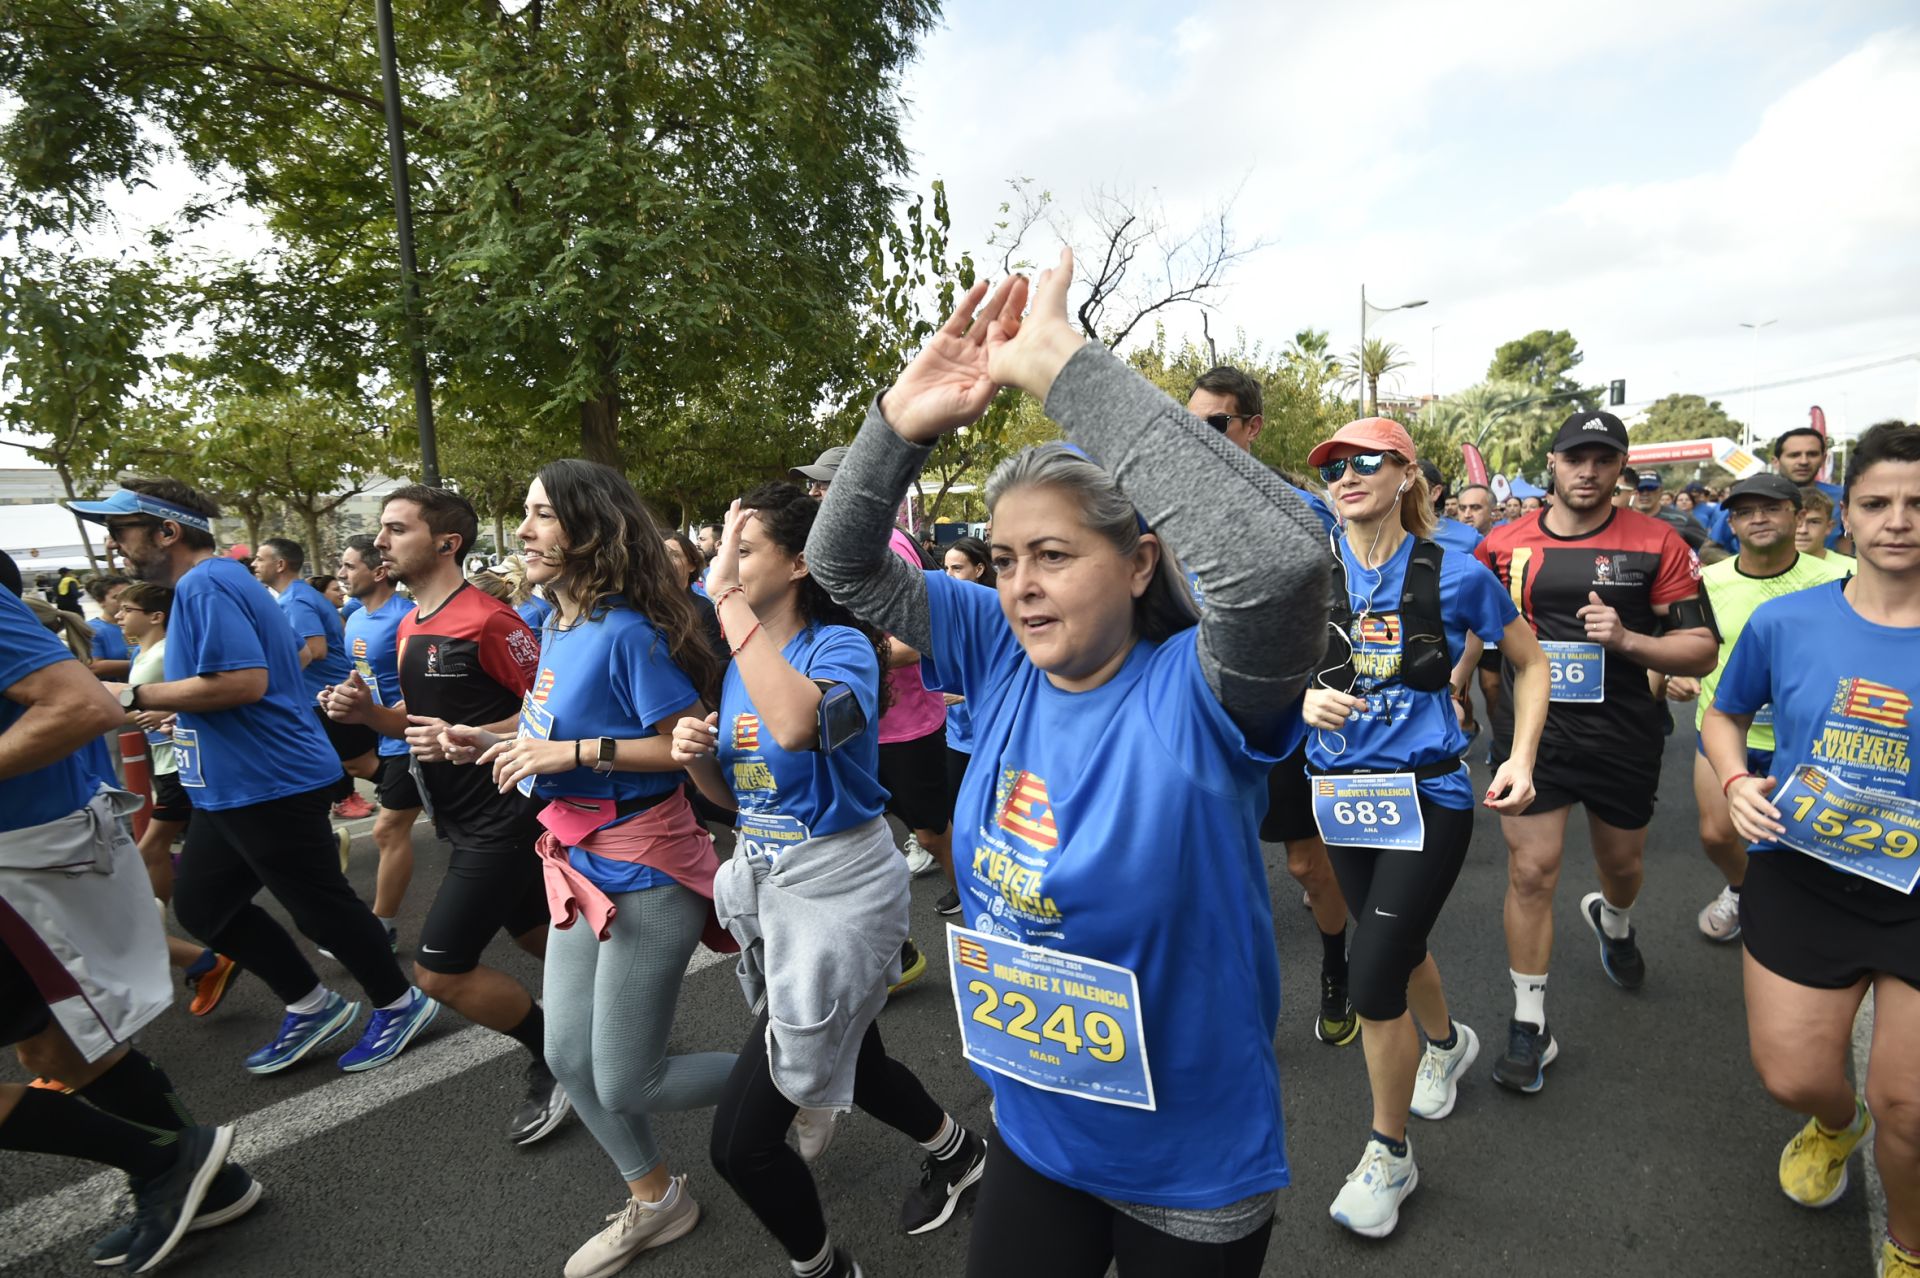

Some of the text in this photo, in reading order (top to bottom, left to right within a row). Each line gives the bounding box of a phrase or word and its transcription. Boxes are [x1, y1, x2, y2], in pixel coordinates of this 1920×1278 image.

[1549, 661, 1585, 684] 66
[1823, 728, 1908, 756] MUÉVETE
[174, 747, 191, 769] 51
[1811, 739, 1911, 773] X VALENCIA
[1337, 787, 1369, 798] MUÉVETE
[1376, 787, 1411, 797] VALENCIA
[1333, 801, 1401, 825] 683
[1792, 795, 1919, 859] 1529
[993, 963, 1129, 1010] MUÉVETE X VALENCIA
[968, 979, 1126, 1063] 2249
[1029, 1049, 1061, 1066] MARI
